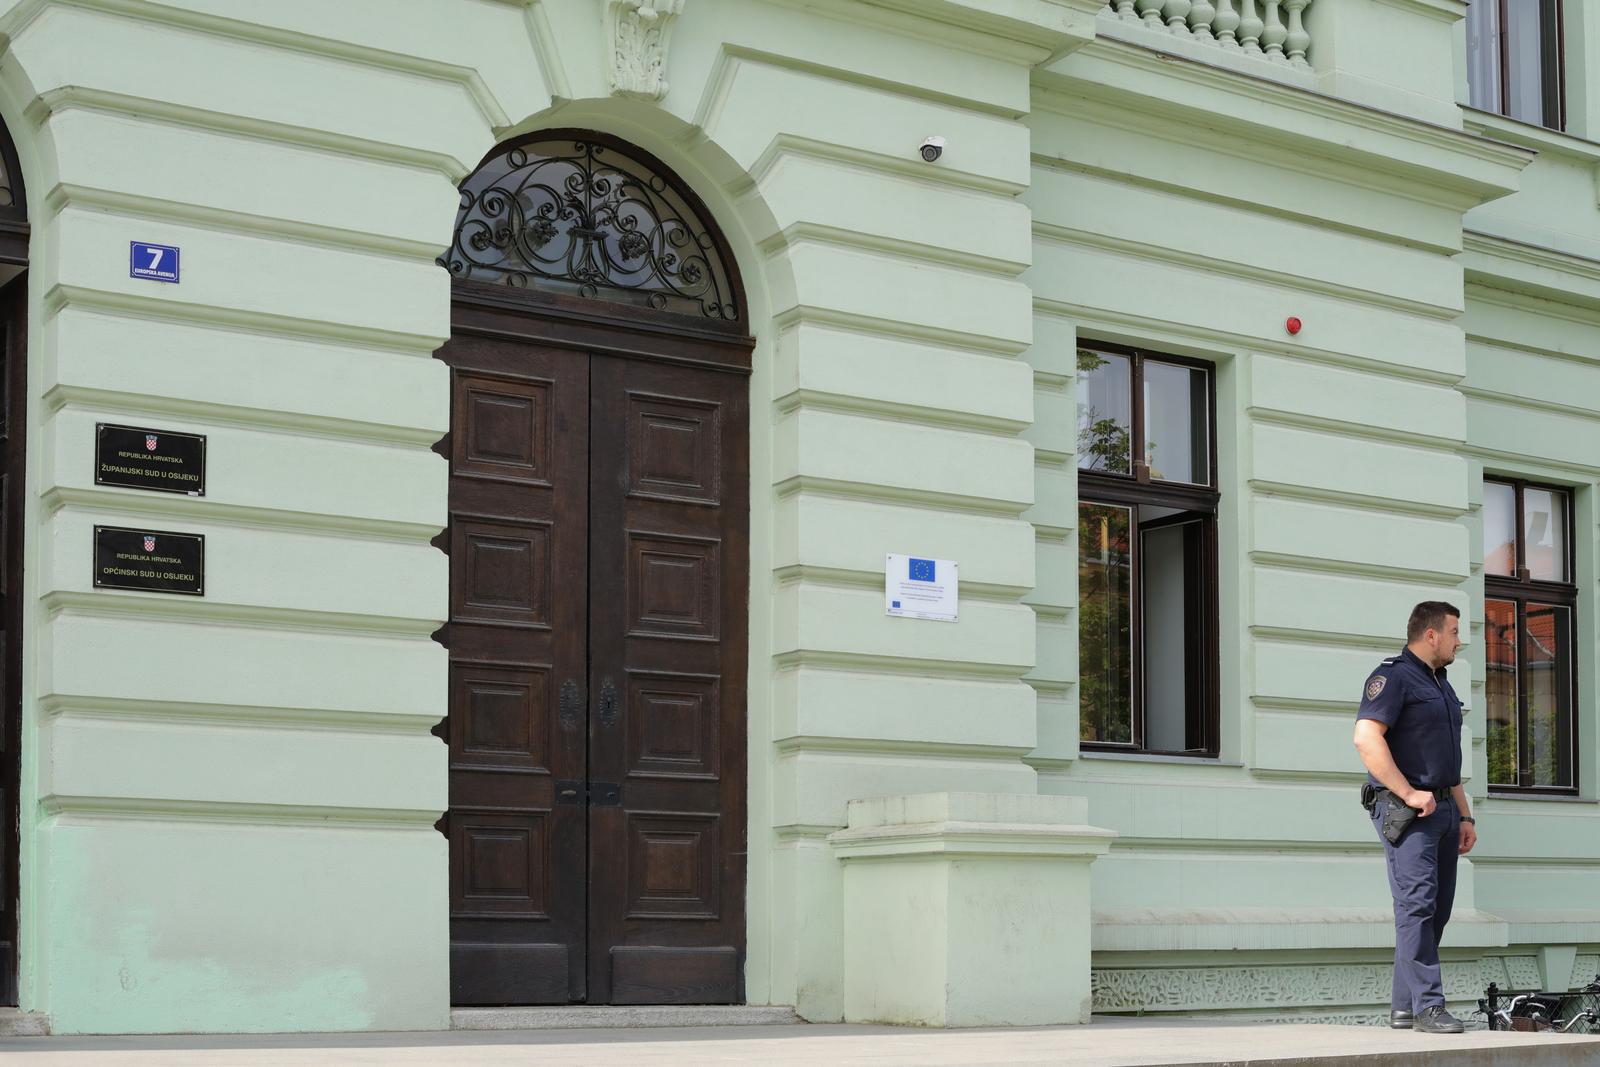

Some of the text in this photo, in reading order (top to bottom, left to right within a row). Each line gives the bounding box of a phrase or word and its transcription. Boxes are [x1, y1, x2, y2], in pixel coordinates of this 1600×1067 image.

[147, 248, 163, 270] 7
[118, 451, 183, 464] REPUBLIKA HRVATSKA
[101, 463, 143, 475] ŽUPANIJSKI
[145, 469, 160, 477] SUD
[168, 472, 199, 482] OSIJEKU
[116, 553, 182, 564] REPUBLIKA HRVATSKA
[103, 566, 138, 576] OPĆINSKI
[140, 570, 155, 578] SUD
[163, 572, 194, 581] OSIJEKU
